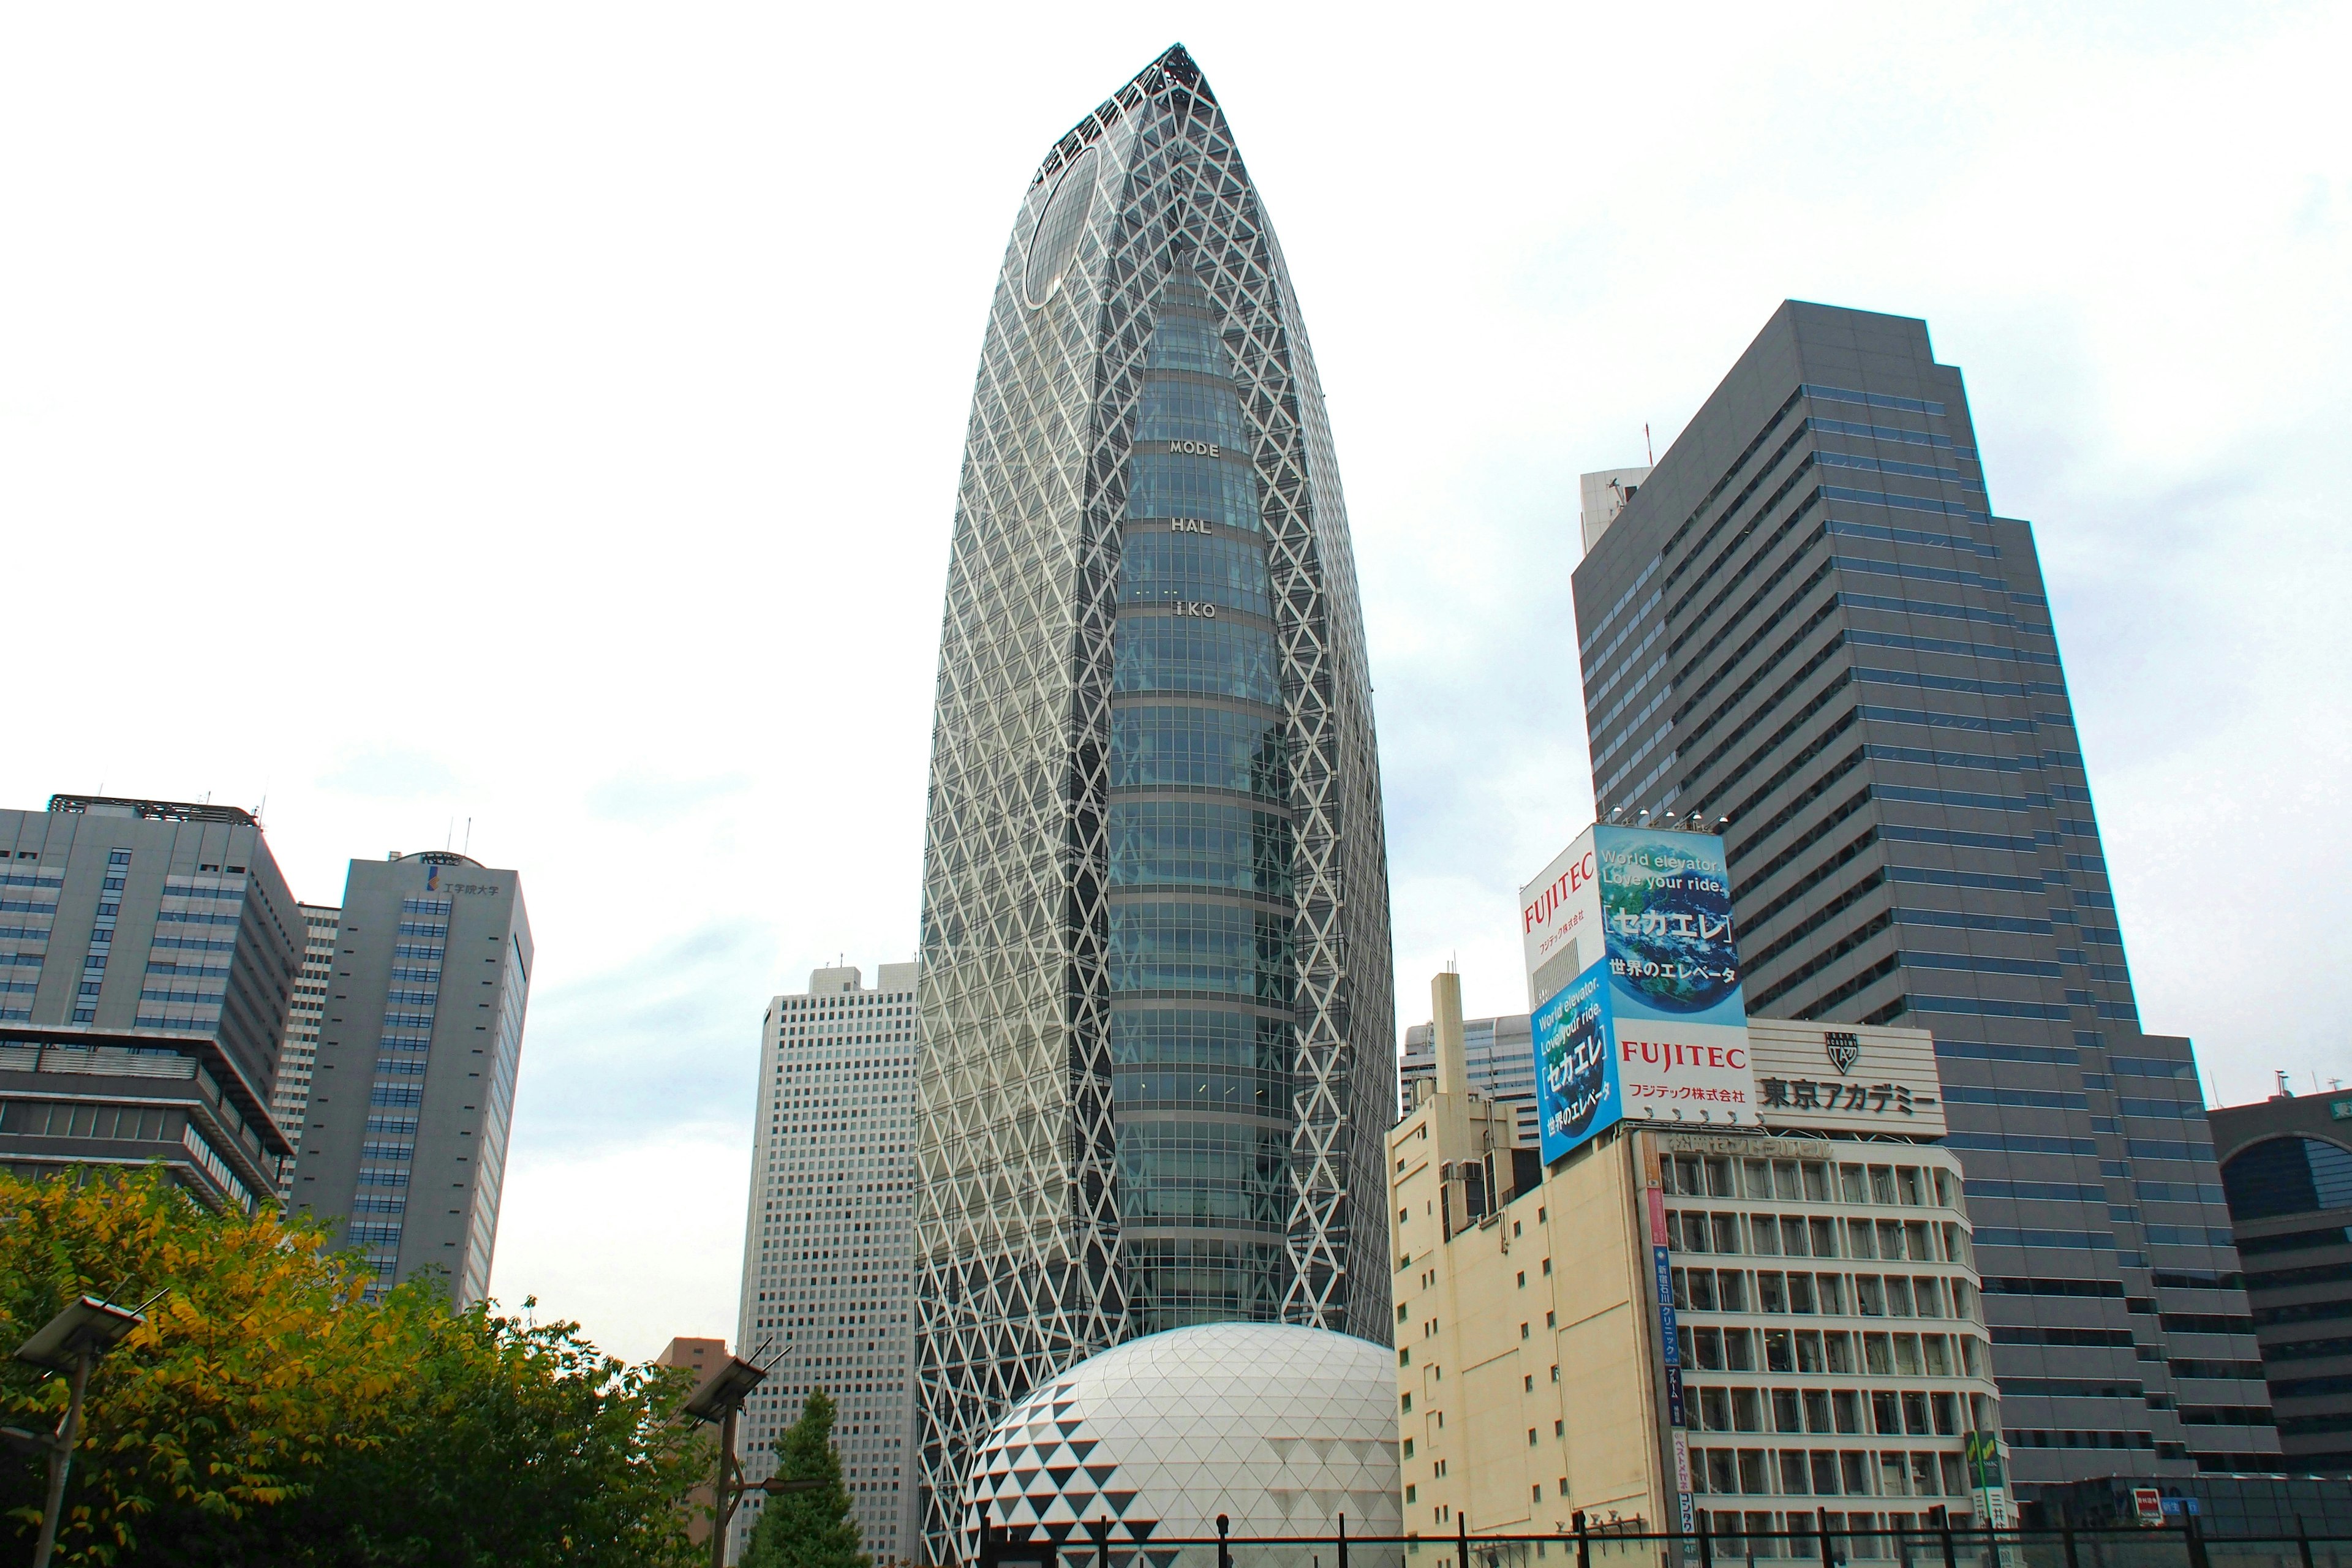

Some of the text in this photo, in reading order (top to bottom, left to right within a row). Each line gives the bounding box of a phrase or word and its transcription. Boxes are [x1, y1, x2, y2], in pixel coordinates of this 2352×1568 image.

[1170, 440, 1220, 458] MODE
[1171, 518, 1212, 535] HAL
[1602, 850, 1722, 873] World elevator.
[443, 883, 499, 896] 工学院大学
[1524, 850, 1594, 935] FUJITEC
[1603, 869, 1724, 892] Love your ride.
[1539, 910, 1585, 956] フジテック株式会社
[1610, 957, 1736, 984] 世界のエレベータ
[1538, 976, 1600, 1033] World elevator.
[1540, 1002, 1602, 1057] Love your ride.
[1622, 1041, 1747, 1073] FUJITEC
[1629, 1084, 1746, 1104] フジテック株式会社
[1760, 1076, 1936, 1115] 東京アカデミー
[1547, 1080, 1611, 1138] 世界のエレベータ
[1669, 1133, 1834, 1159] 松岡セントラルビル
[1681, 1493, 1692, 1543] コンタク
